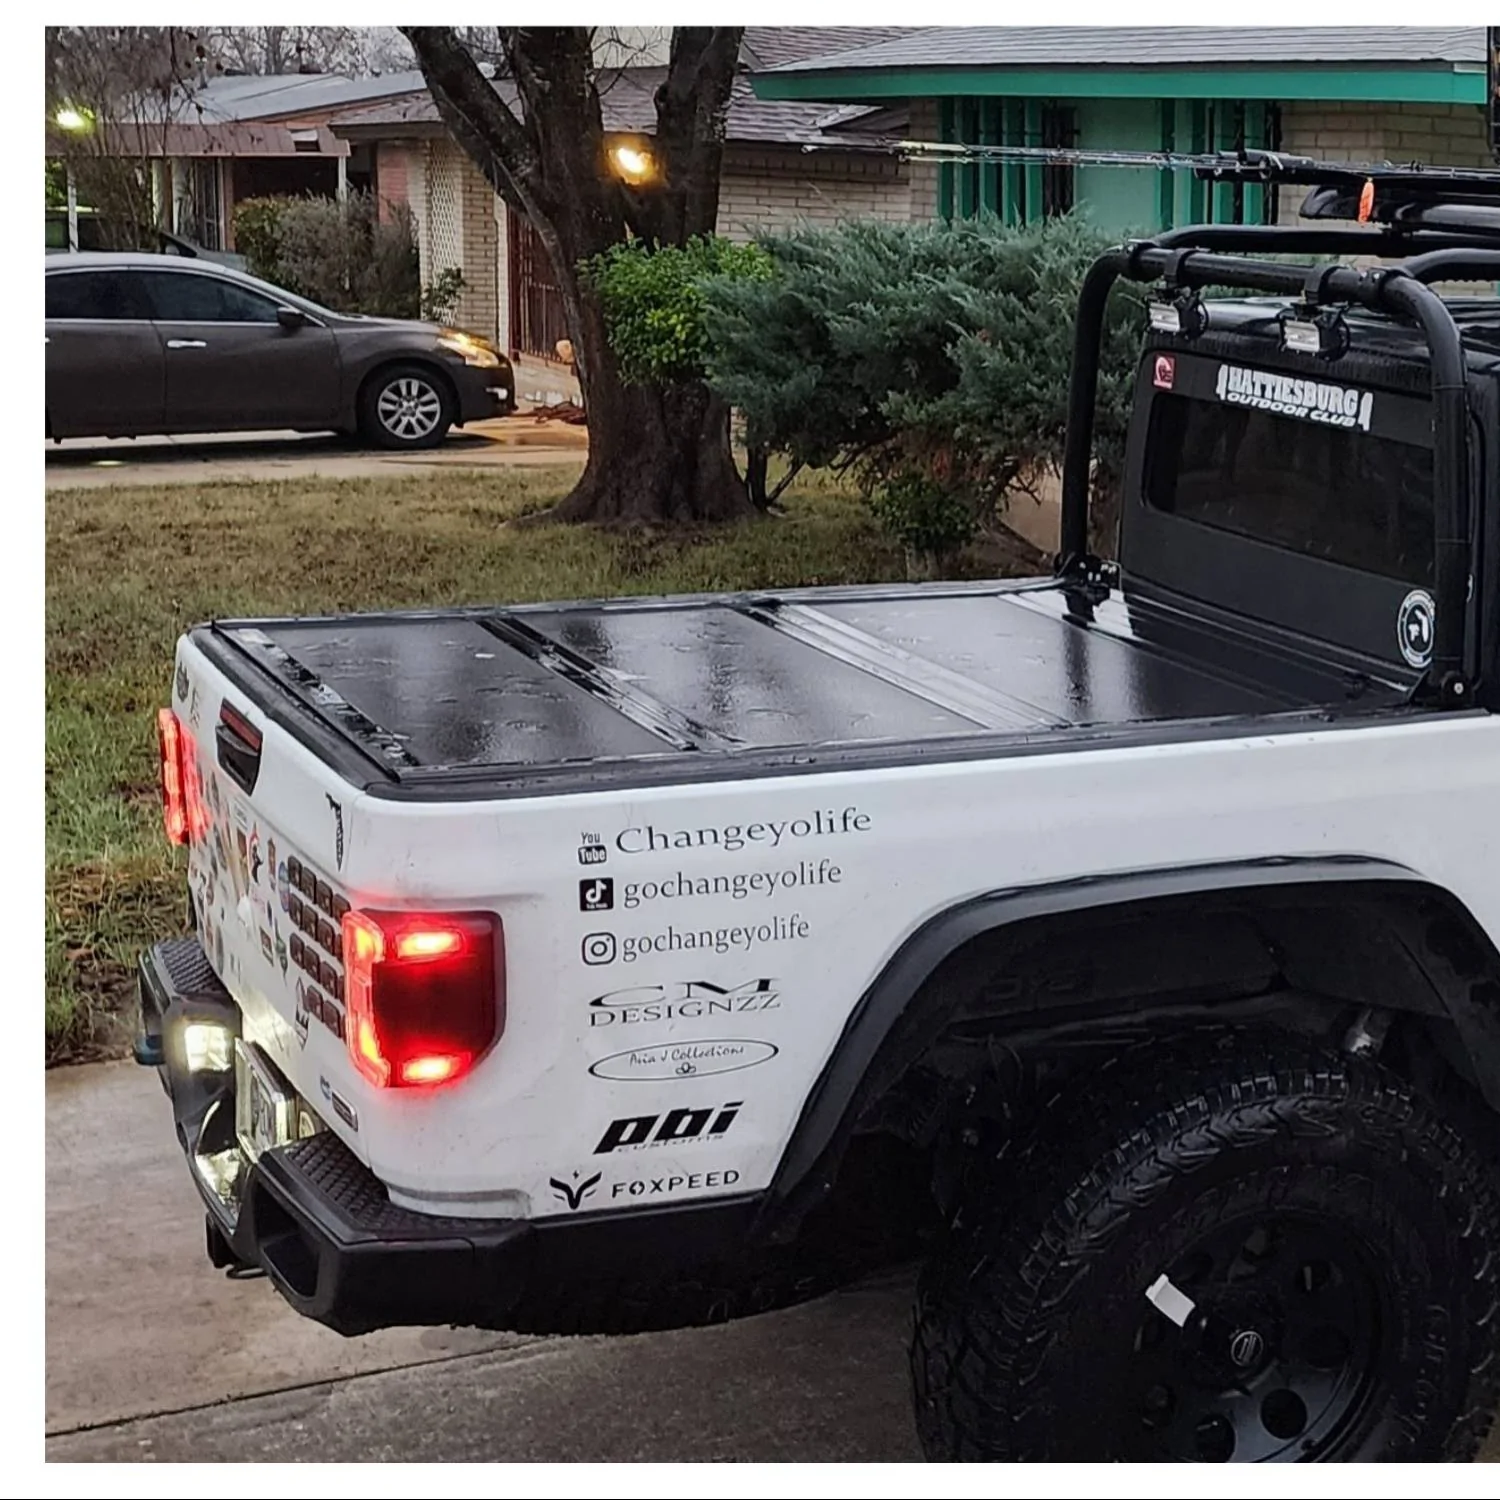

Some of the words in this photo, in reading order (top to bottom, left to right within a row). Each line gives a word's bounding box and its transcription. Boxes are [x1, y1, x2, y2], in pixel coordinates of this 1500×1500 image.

[1227, 365, 1359, 416] HATTIESBURG
[1227, 392, 1309, 418] OUTDOOR
[1310, 410, 1357, 428] CLUB
[616, 807, 872, 854] Changeyolife
[624, 859, 842, 908] gochangeyolife
[622, 914, 810, 963] gochangeyolife
[590, 993, 781, 1027] DESIGNZZ
[611, 1170, 740, 1199] FOXPEED
